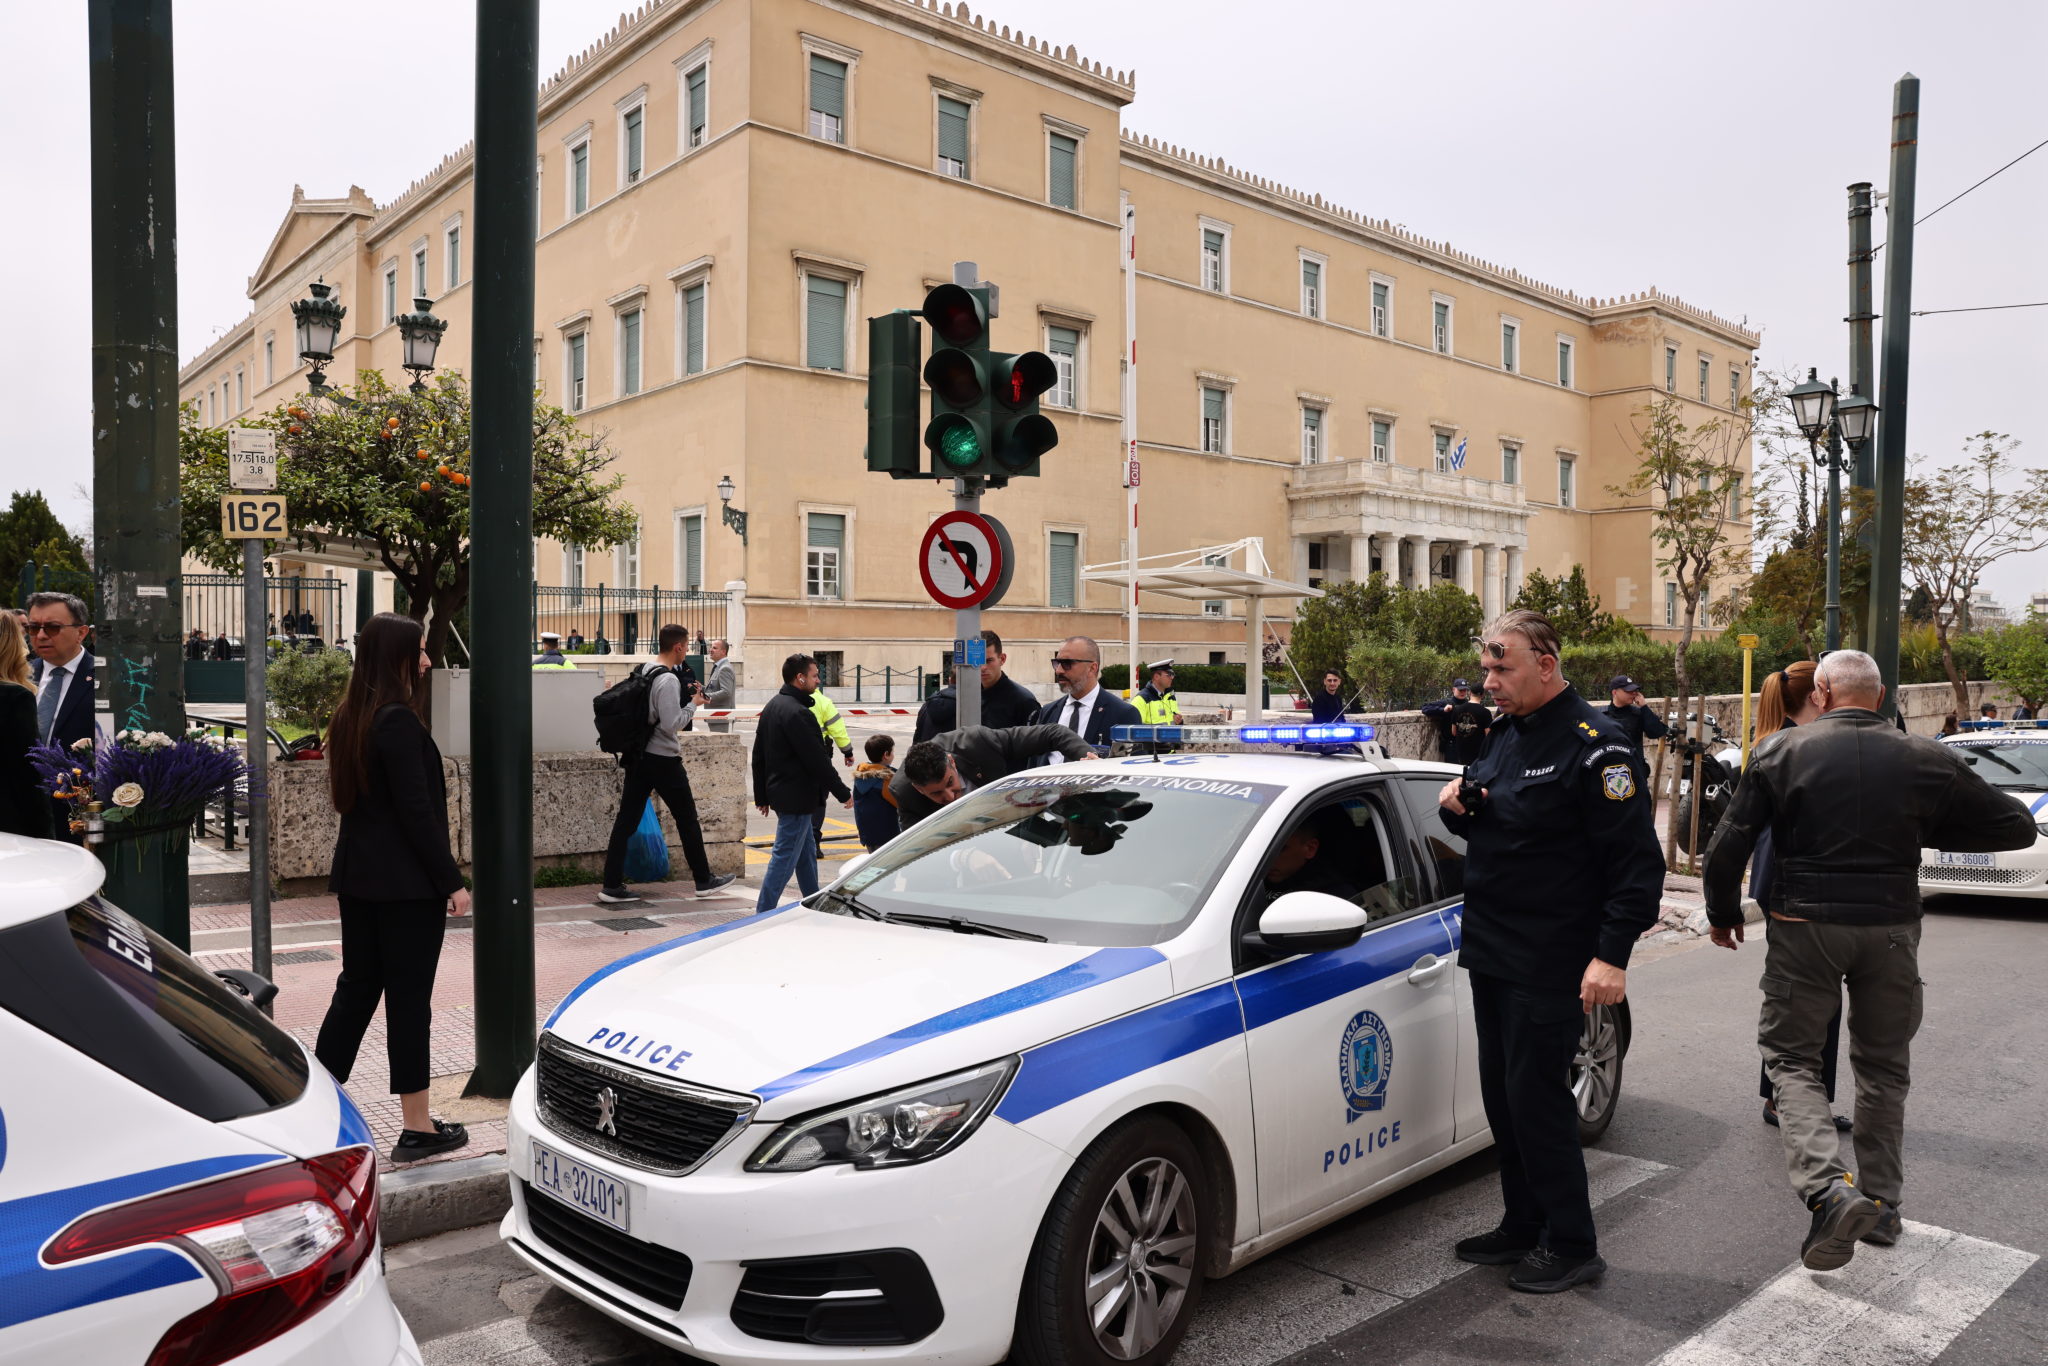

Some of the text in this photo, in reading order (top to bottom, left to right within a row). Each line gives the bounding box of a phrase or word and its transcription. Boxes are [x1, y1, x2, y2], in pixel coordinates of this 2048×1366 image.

[232, 453, 274, 464] 17.5 18.0
[249, 465, 263, 475] 3.8
[1131, 462, 1139, 486] STOP
[226, 501, 282, 532] 162
[1524, 765, 1555, 777] POLICE
[993, 775, 1254, 799] ΕΛΛΗΝΙΚΗ ΑΣΤΥΝΟΜΙΑ
[586, 1027, 694, 1071] POLICE
[1340, 1012, 1392, 1099] ΕΛΛΗΝΙΚΗ ΑΣΤΥΝΟΜΙΑ
[1323, 1120, 1401, 1174] POLICE
[571, 1166, 616, 1220] 32401
